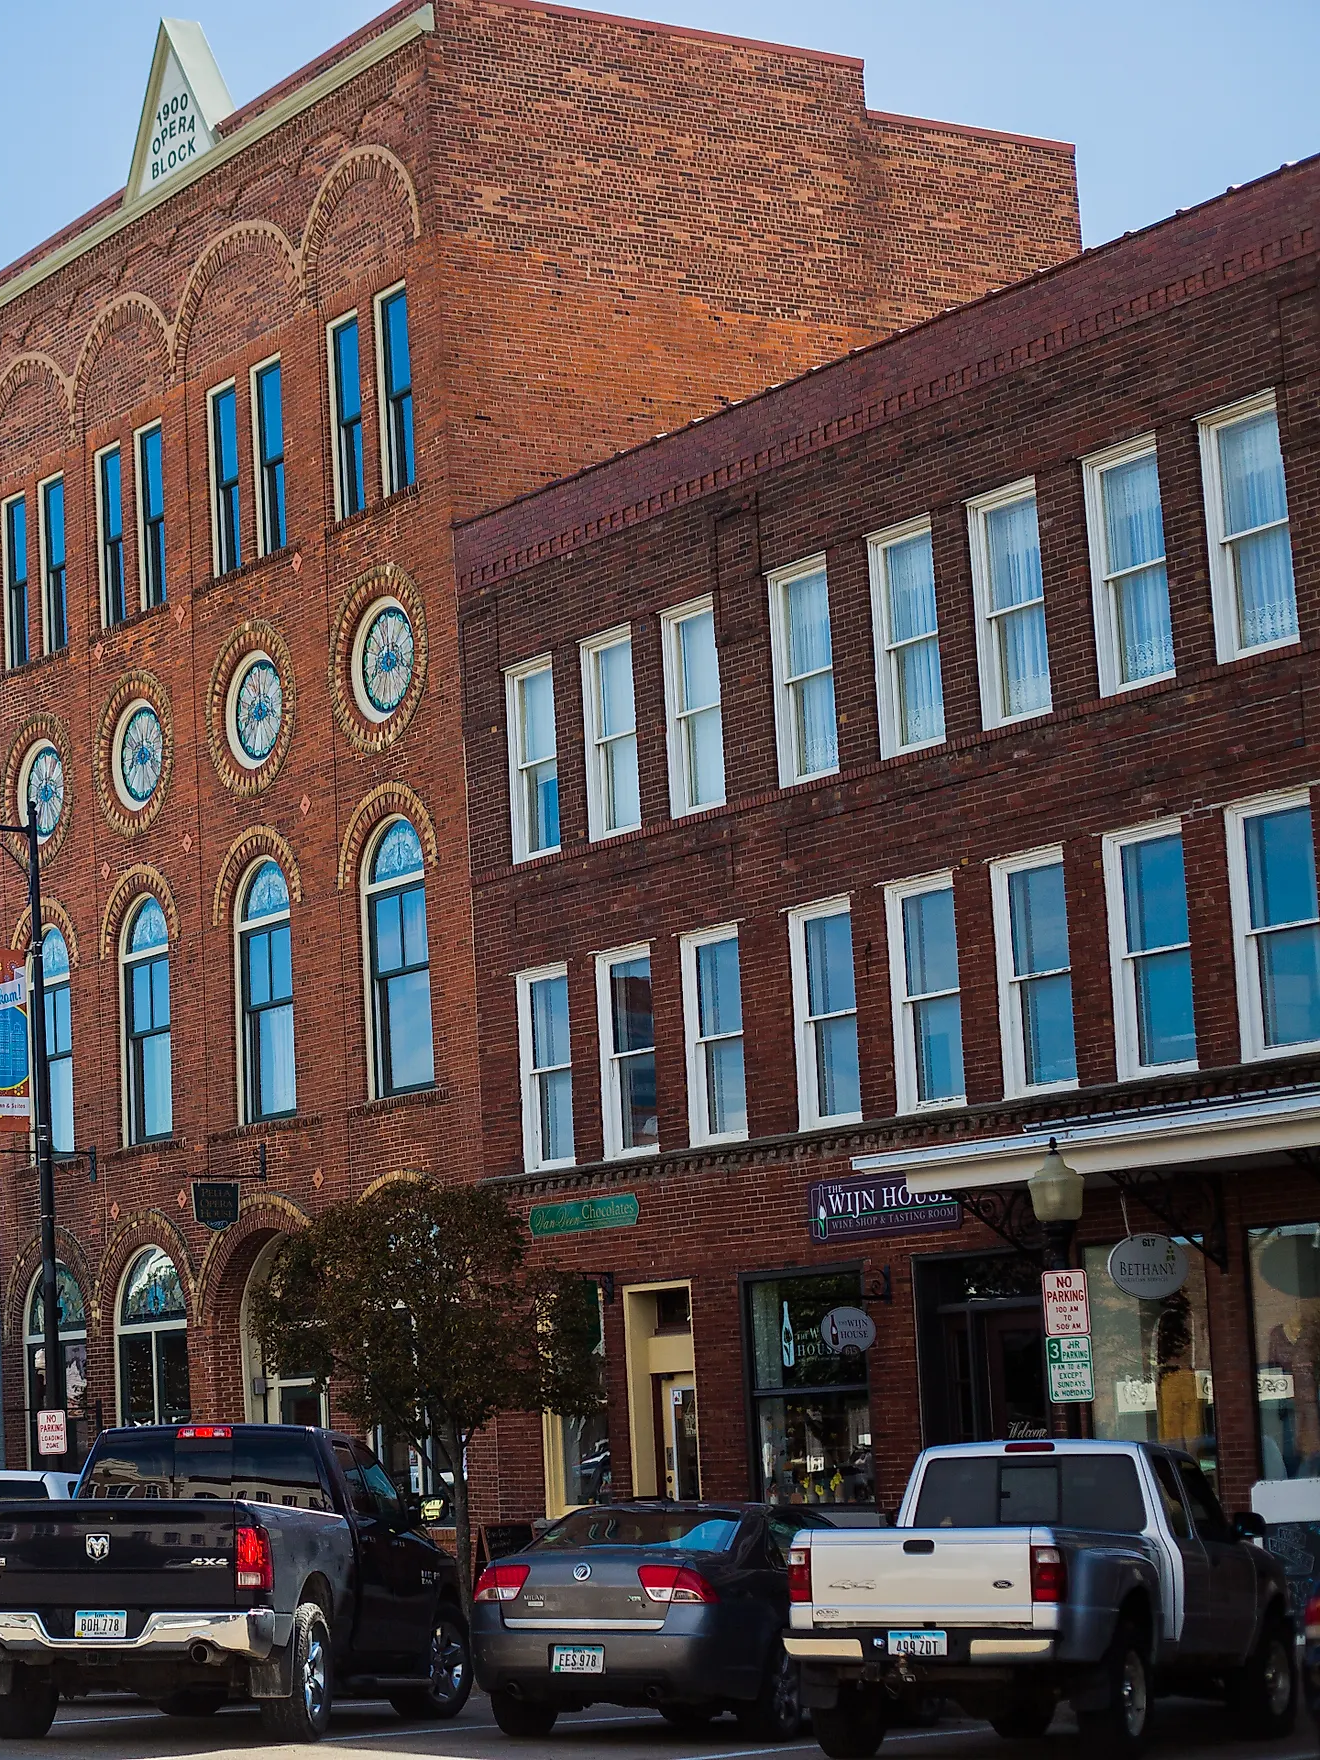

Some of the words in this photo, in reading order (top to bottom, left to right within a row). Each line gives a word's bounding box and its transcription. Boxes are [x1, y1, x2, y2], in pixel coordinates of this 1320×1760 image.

[156, 92, 189, 127] 1900
[152, 114, 196, 155] OPERA
[151, 137, 197, 180] BLOCK
[201, 1188, 231, 1197] PELLA
[827, 1184, 843, 1194] THE
[200, 1199, 233, 1208] OPERA
[828, 1189, 876, 1218] WIJN
[201, 1209, 234, 1218] HOUSE
[581, 1201, 634, 1220] Chocolates
[832, 1220, 854, 1230] WINE
[855, 1217, 878, 1227] SHOP
[888, 1209, 926, 1223] TASTING
[929, 1207, 955, 1218] ROOM
[1142, 1238, 1156, 1247] 617
[1120, 1261, 1176, 1276] BETHANY
[1056, 1275, 1072, 1288] NO
[1046, 1289, 1085, 1303] PARKING
[847, 1319, 868, 1328] WIJN
[840, 1331, 869, 1339] HOUSE
[1050, 1343, 1060, 1359] 3
[1062, 1351, 1089, 1359] PARKING
[1059, 1371, 1083, 1380] EXCEPT
[1057, 1380, 1086, 1389] SUNDAYS
[46, 1414, 57, 1423] NO
[40, 1424, 63, 1433] PARKING
[41, 1434, 63, 1442] LOADING
[81, 1618, 99, 1631] BOH
[102, 1618, 119, 1631] 778
[559, 1653, 577, 1667] EES
[579, 1654, 597, 1667] 978
